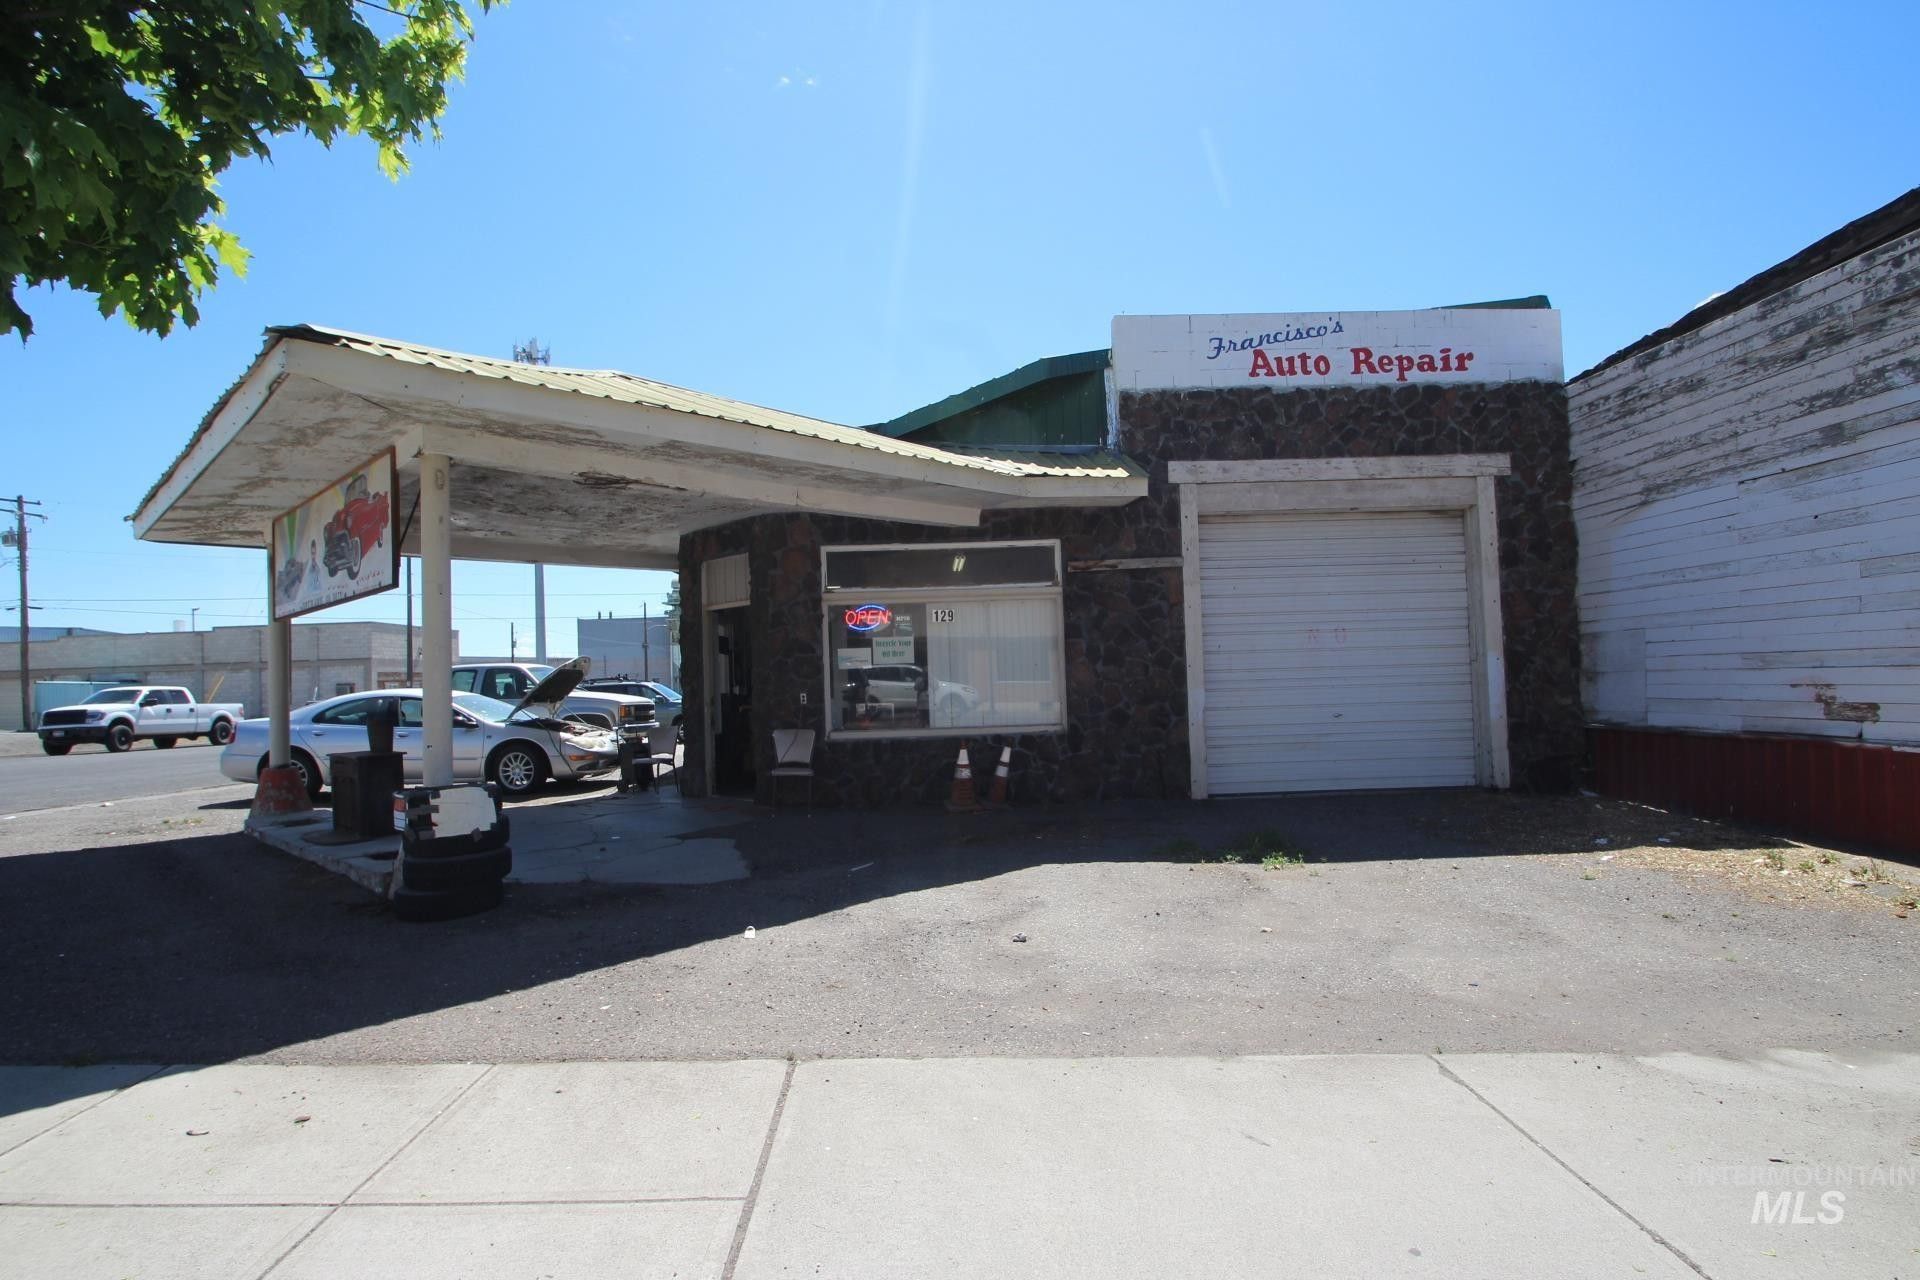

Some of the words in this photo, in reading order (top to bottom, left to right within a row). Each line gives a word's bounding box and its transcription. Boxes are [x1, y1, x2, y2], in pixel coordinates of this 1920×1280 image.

[1207, 317, 1344, 359] Francisco's
[1249, 349, 1331, 377] Auto
[1350, 347, 1474, 381] Repair
[845, 609, 889, 625] OPEN
[934, 610, 954, 622] 129
